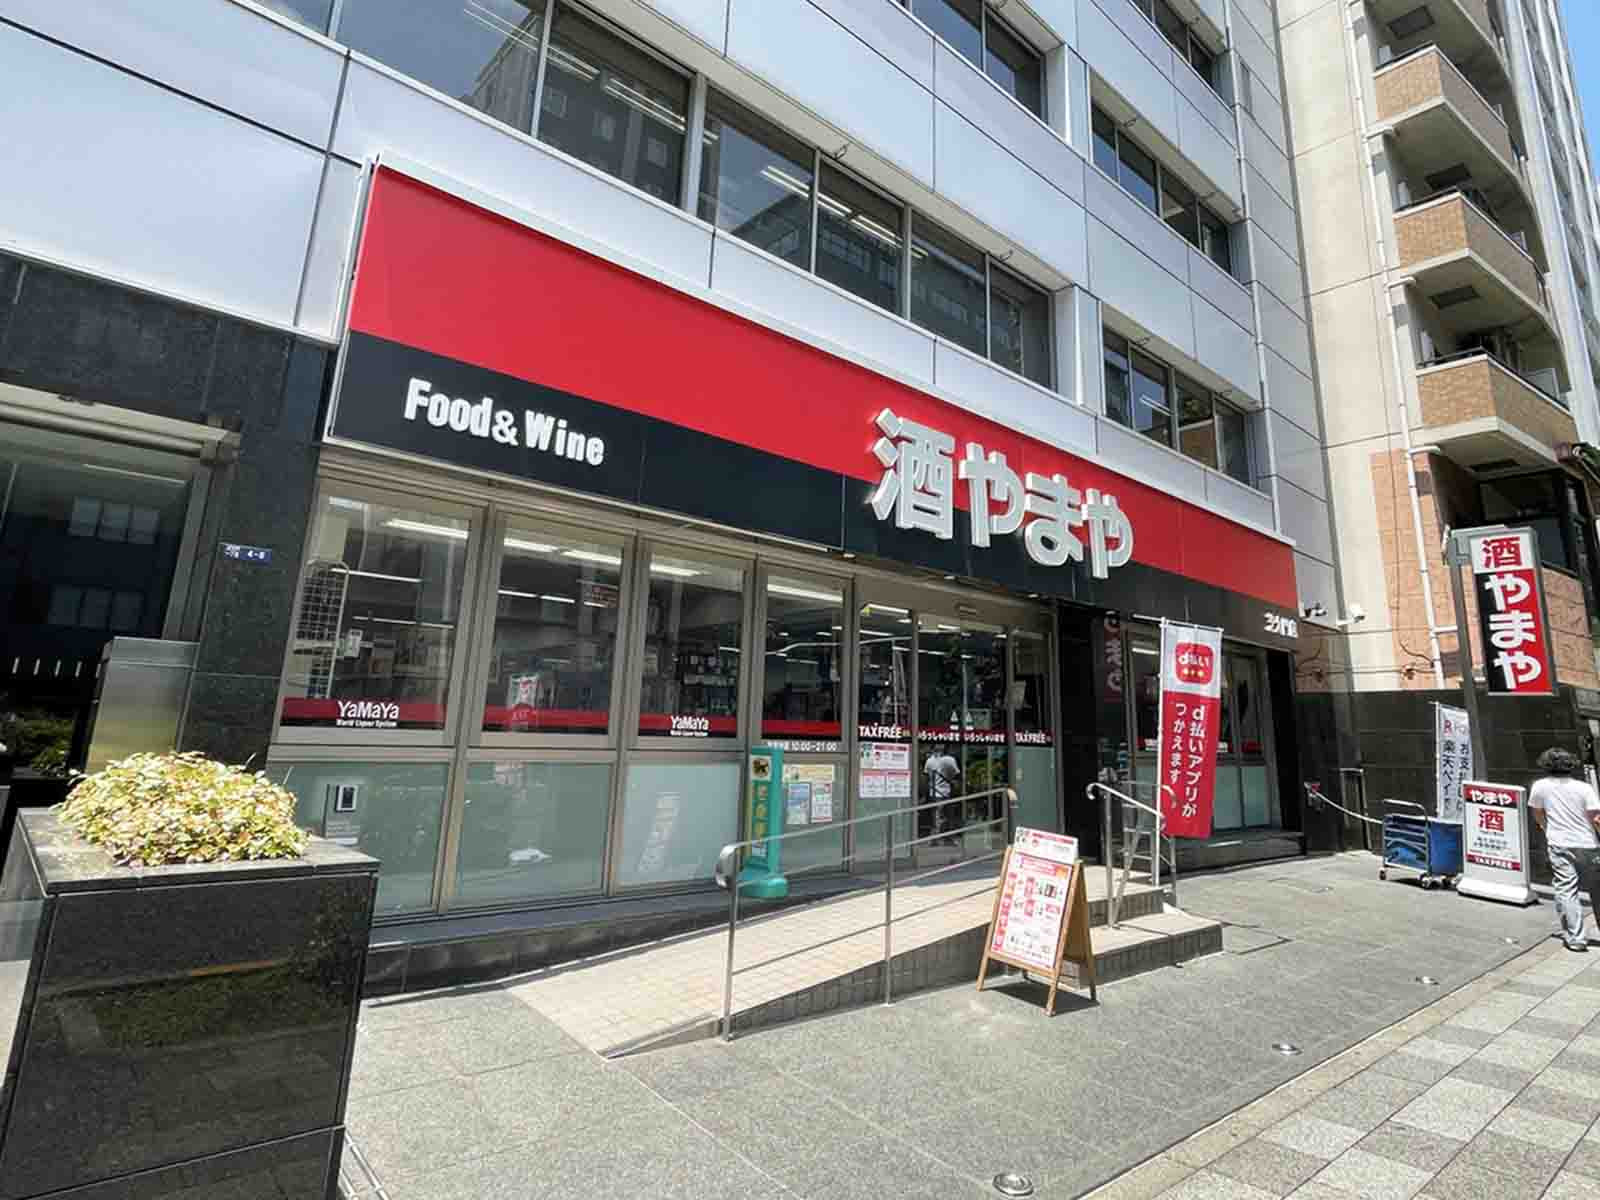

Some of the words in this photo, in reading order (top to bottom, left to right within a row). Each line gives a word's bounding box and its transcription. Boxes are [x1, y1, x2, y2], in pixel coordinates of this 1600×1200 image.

[525, 410, 605, 466] Wine
[871, 407, 1134, 579] 酒やまや
[1482, 536, 1543, 690] 酒やまや
[337, 701, 400, 719] YaMaYa
[1169, 703, 1187, 784] つかえます
[1181, 703, 1206, 818] d払いアプリが
[1469, 789, 1513, 806] やまや
[1478, 808, 1505, 832] 酒
